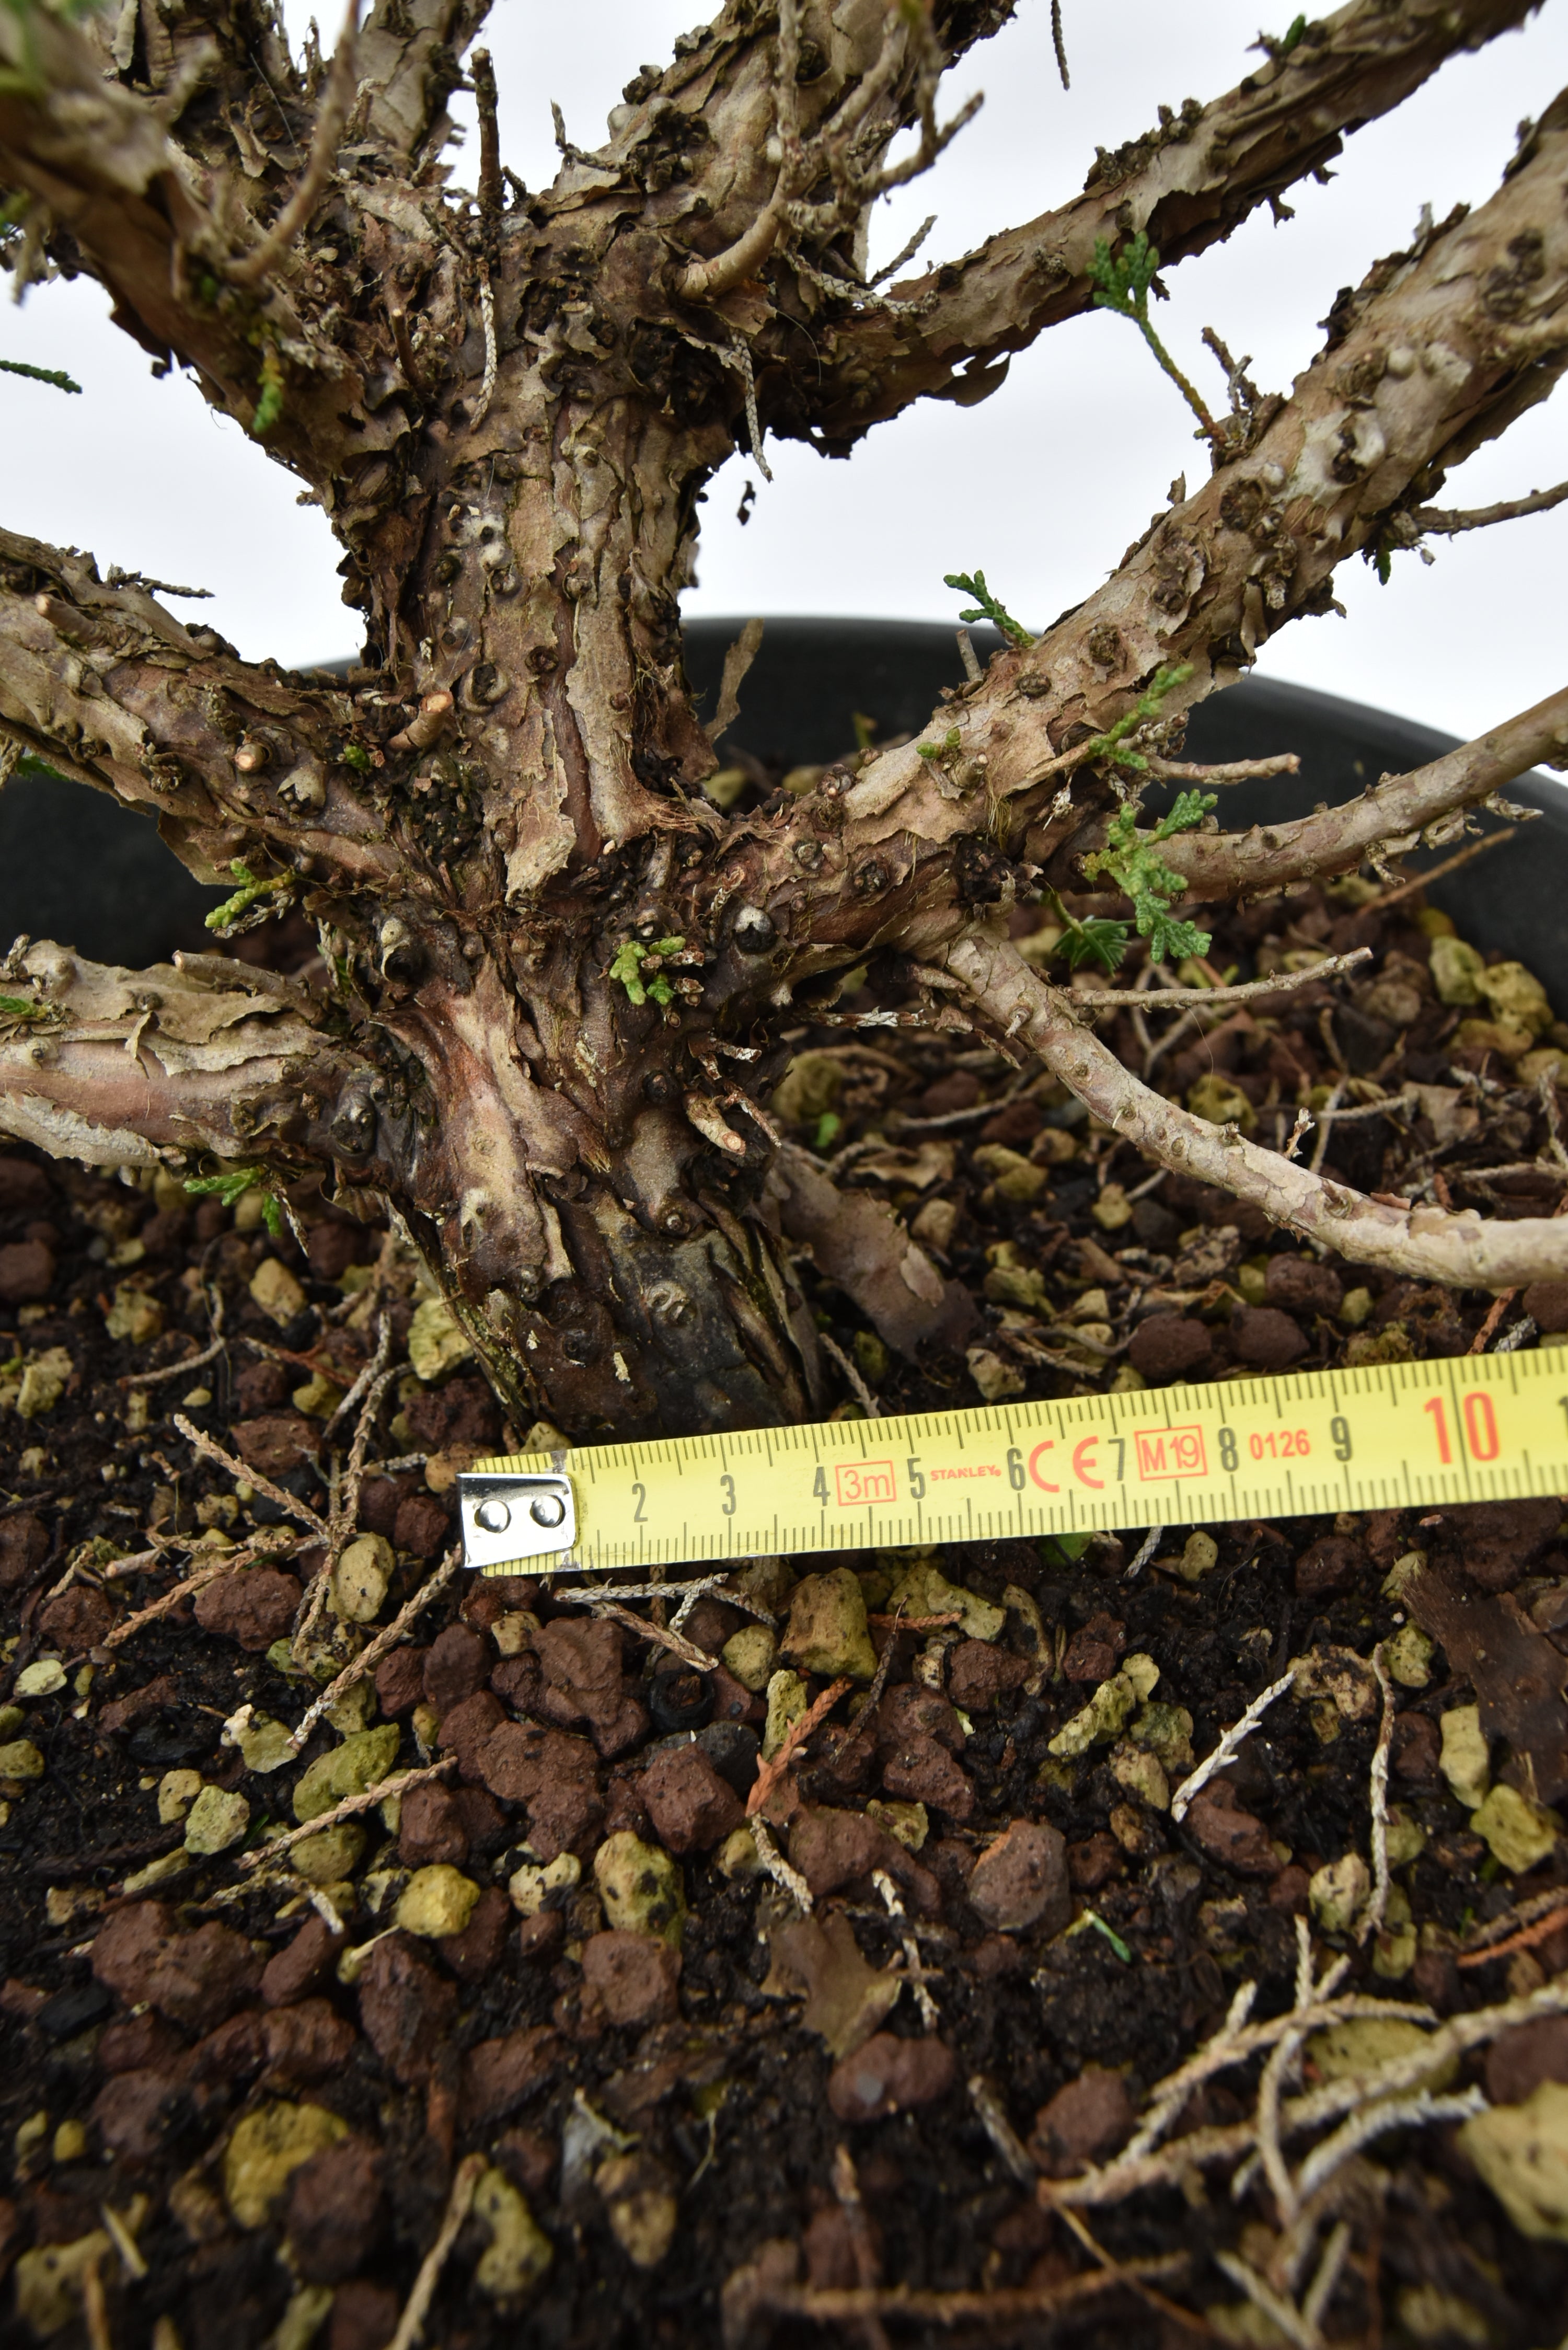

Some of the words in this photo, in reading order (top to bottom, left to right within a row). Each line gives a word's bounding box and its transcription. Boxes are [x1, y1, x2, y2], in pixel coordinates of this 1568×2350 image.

[631, 1482, 649, 1523] 2
[720, 1474, 737, 1516] 3
[813, 1466, 831, 1507] 4
[844, 1469, 891, 1500] 3m
[907, 1457, 926, 1500] 5
[930, 1465, 997, 1481] STANLEY
[1007, 1447, 1027, 1491] 6
[1029, 1435, 1105, 1493] CE
[1108, 1437, 1125, 1481] 7
[1142, 1434, 1201, 1472] M19
[1218, 1427, 1239, 1472] 8
[1249, 1429, 1311, 1460] 0126
[1330, 1415, 1353, 1462] 9
[1424, 1391, 1500, 1465] 10
